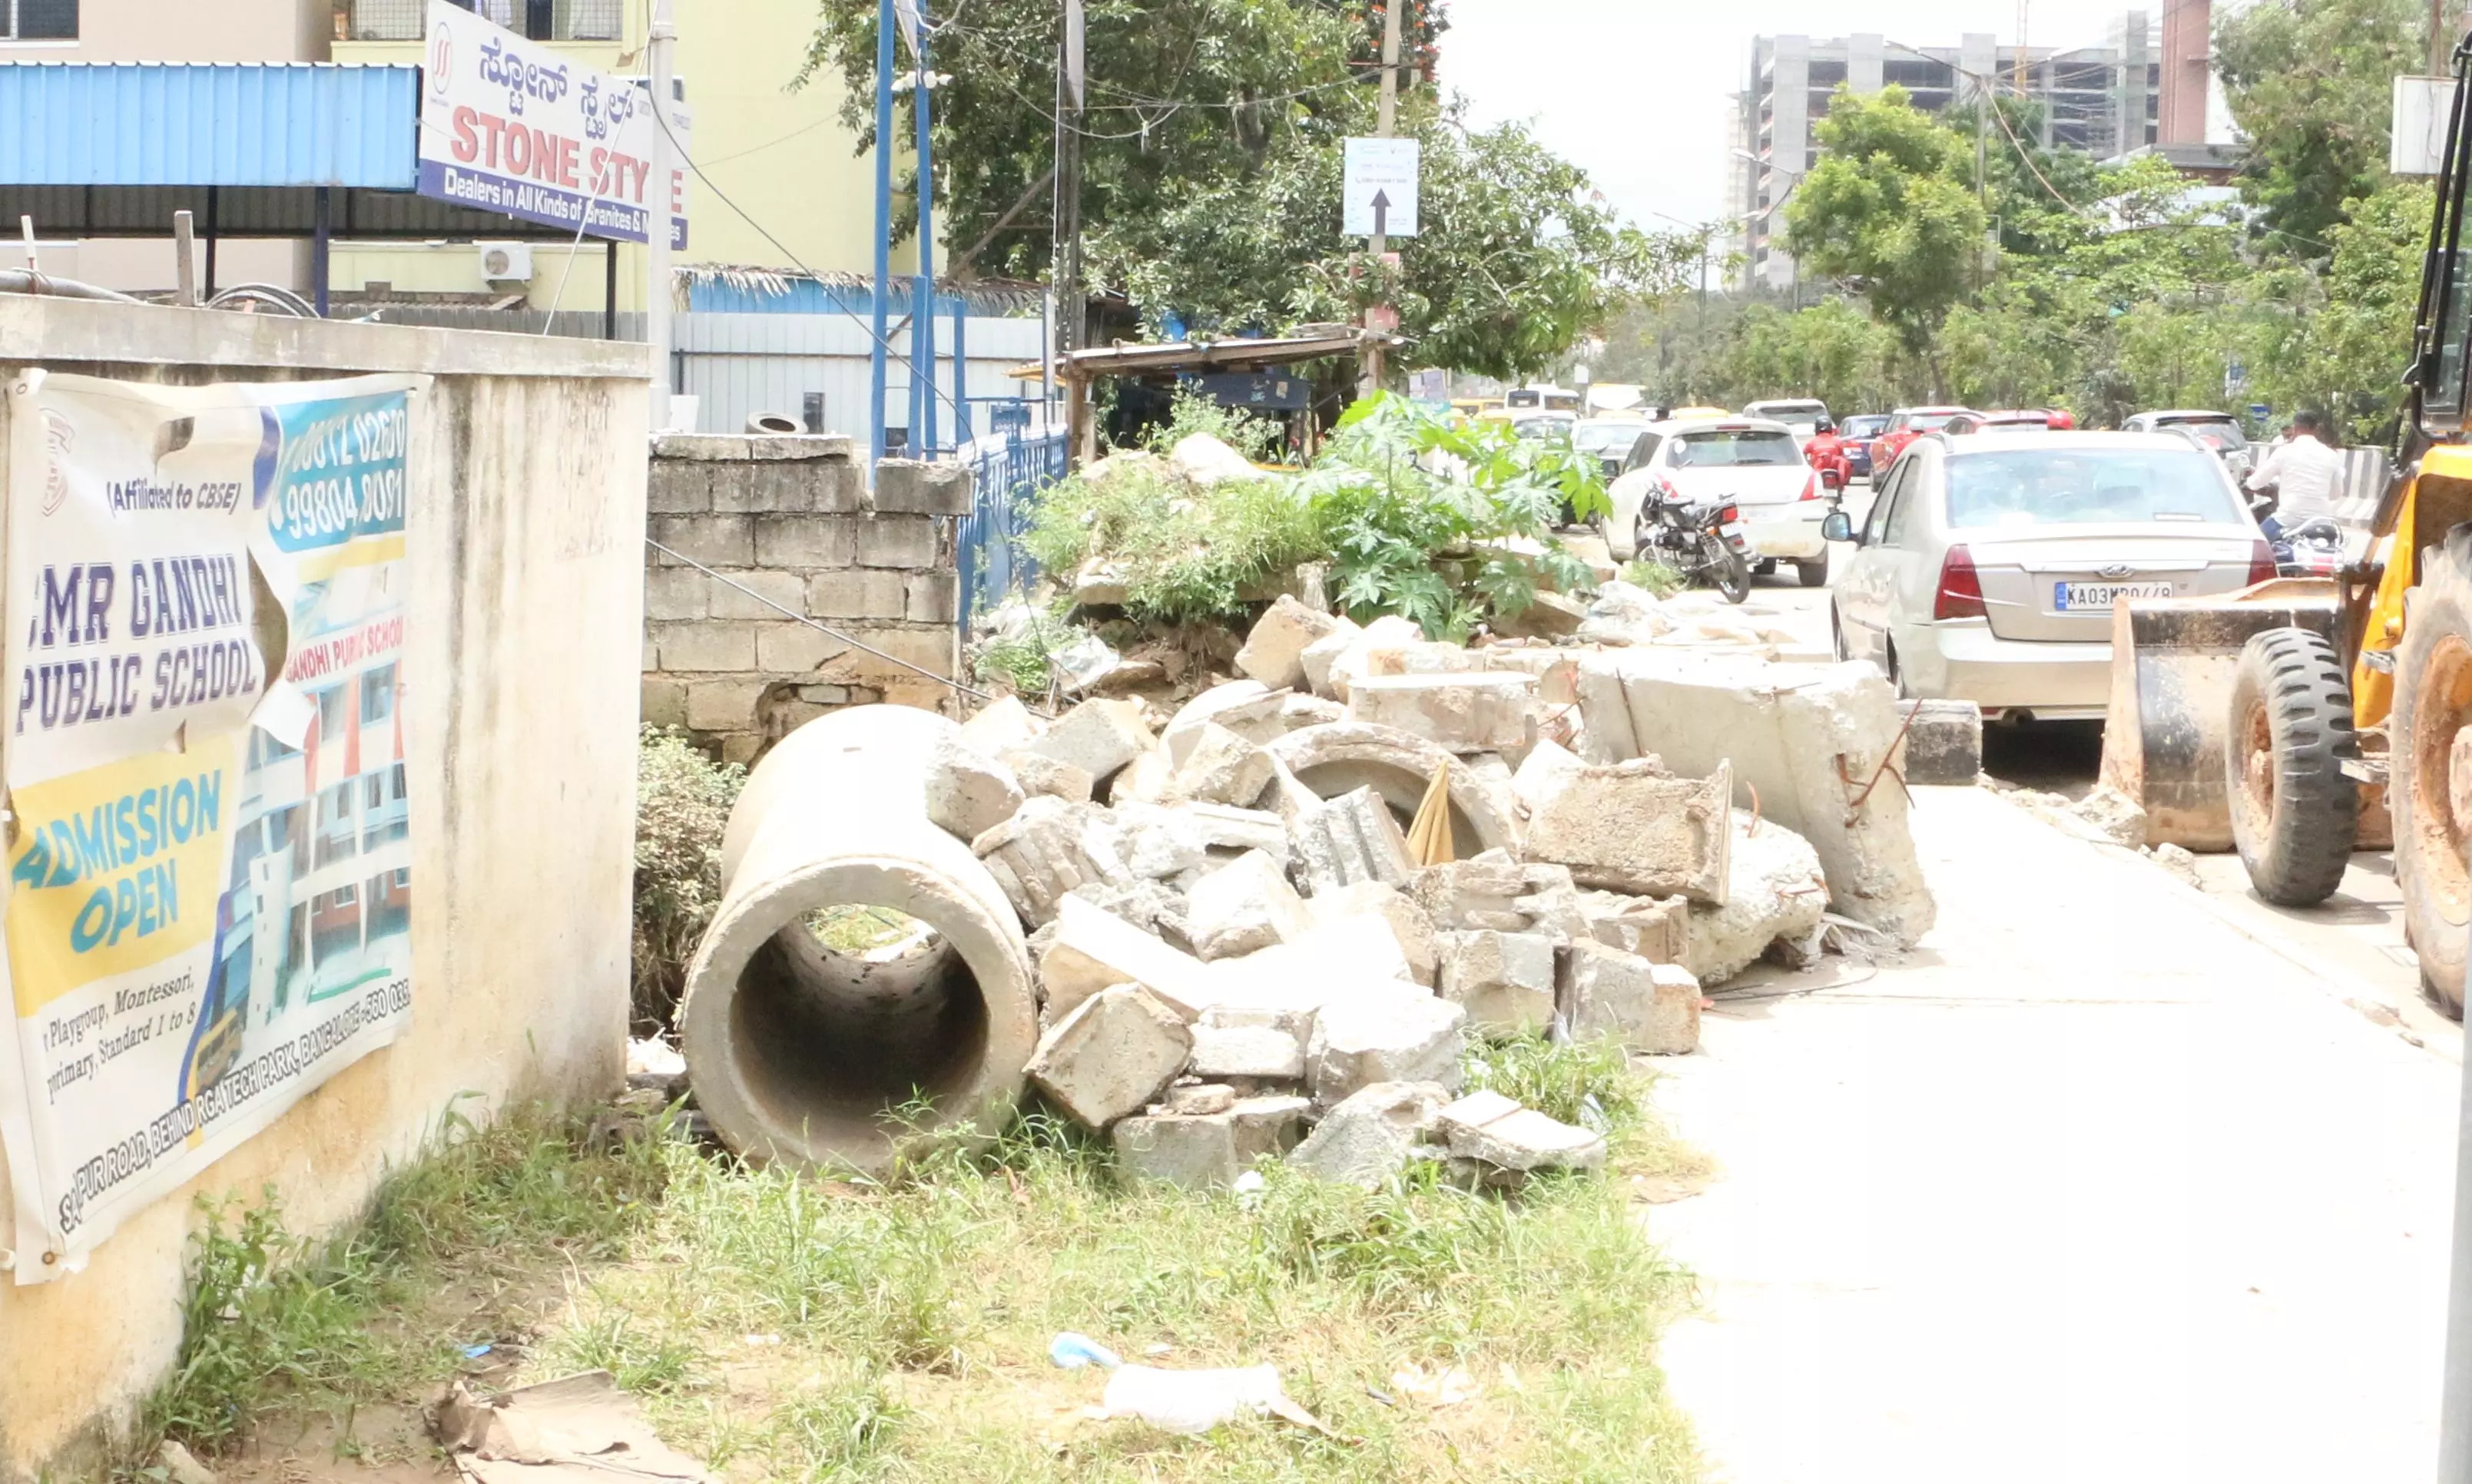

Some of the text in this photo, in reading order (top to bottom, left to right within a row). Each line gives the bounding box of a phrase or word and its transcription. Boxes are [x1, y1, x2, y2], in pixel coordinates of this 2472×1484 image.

[480, 36, 568, 116] ಸ್ಟೋನ್
[444, 167, 500, 205] Dealers
[502, 180, 514, 208] in
[515, 184, 533, 211] All
[535, 189, 568, 220] Kinds
[569, 197, 583, 221] of
[585, 201, 631, 230] Granites
[632, 210, 641, 233] &
[450, 105, 683, 213] STONE STYE
[107, 478, 242, 518] (Affiliated to CBSE)
[130, 553, 242, 640] GANDHI
[15, 638, 257, 736] PUBLIC SCHOOL
[12, 769, 221, 889] ADMISSION
[70, 858, 178, 954] OPEN
[49, 1003, 109, 1048] Playgroup,
[114, 966, 194, 1015] Montessori,
[98, 1017, 153, 1065] Standard
[169, 1011, 183, 1032] to
[187, 1001, 196, 1025] 8
[106, 1131, 151, 1188] ROAD,
[150, 1099, 194, 1158] BEHIND
[195, 1082, 225, 1128] RGA
[224, 1061, 260, 1108] TECH
[258, 1040, 300, 1088] PARK,
